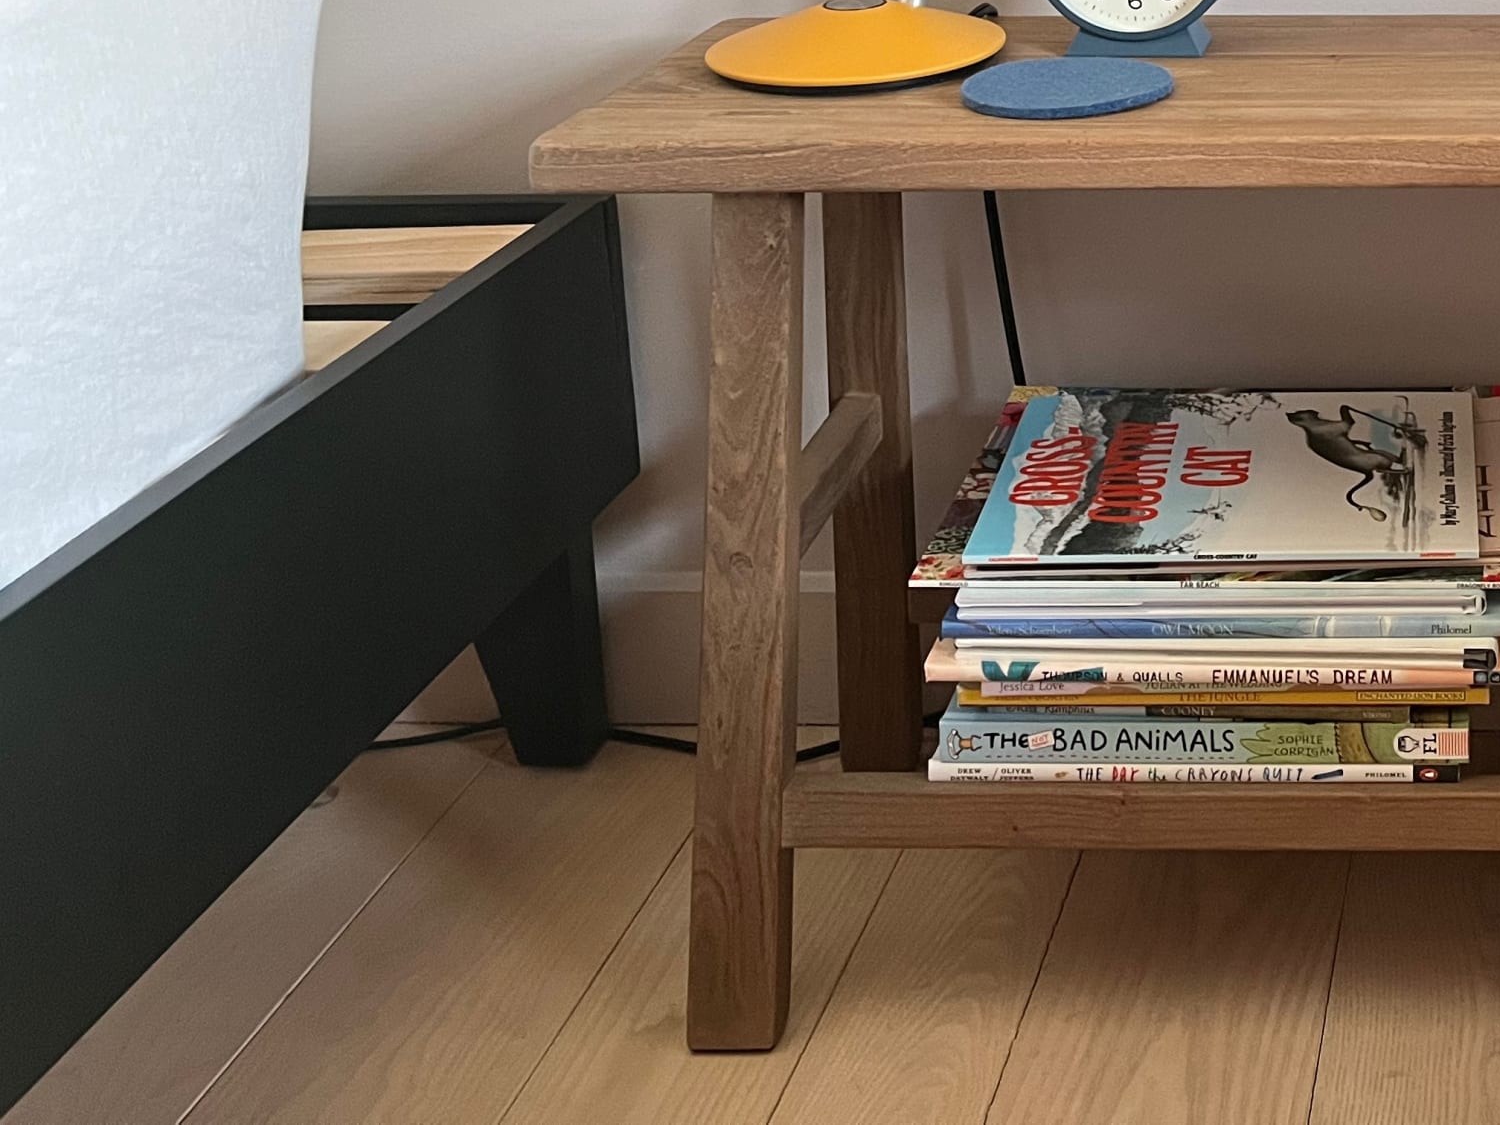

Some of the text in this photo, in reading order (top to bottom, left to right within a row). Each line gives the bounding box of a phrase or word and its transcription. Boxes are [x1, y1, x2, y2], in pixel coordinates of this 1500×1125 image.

[1008, 426, 1097, 507] CROSS-
[1087, 420, 1180, 523] COUNTRY
[1180, 446, 1252, 487] CAT
[1179, 581, 1220, 589] TAR BEACH
[1151, 623, 1235, 636] OWL MOON
[1430, 623, 1473, 635] Philomel
[1041, 671, 1184, 683] THOMPSON & QUALLS
[1211, 669, 1393, 685] EMMANUEL'S DREAM
[999, 681, 1065, 693] Jessica Love
[1180, 692, 1261, 702] THE JUNGLE
[1160, 706, 1217, 716] COONEY
[982, 732, 1030, 749] THE
[1052, 728, 1108, 752] BAD
[1277, 735, 1324, 745] SOPHIE
[1423, 733, 1437, 755] FL
[1273, 746, 1335, 757] CORRIGAN
[1076, 767, 1104, 781] THE
[1112, 765, 1140, 782] DAY
[1174, 766, 1253, 782] CRAYONS
[1262, 766, 1304, 782] QUIT
